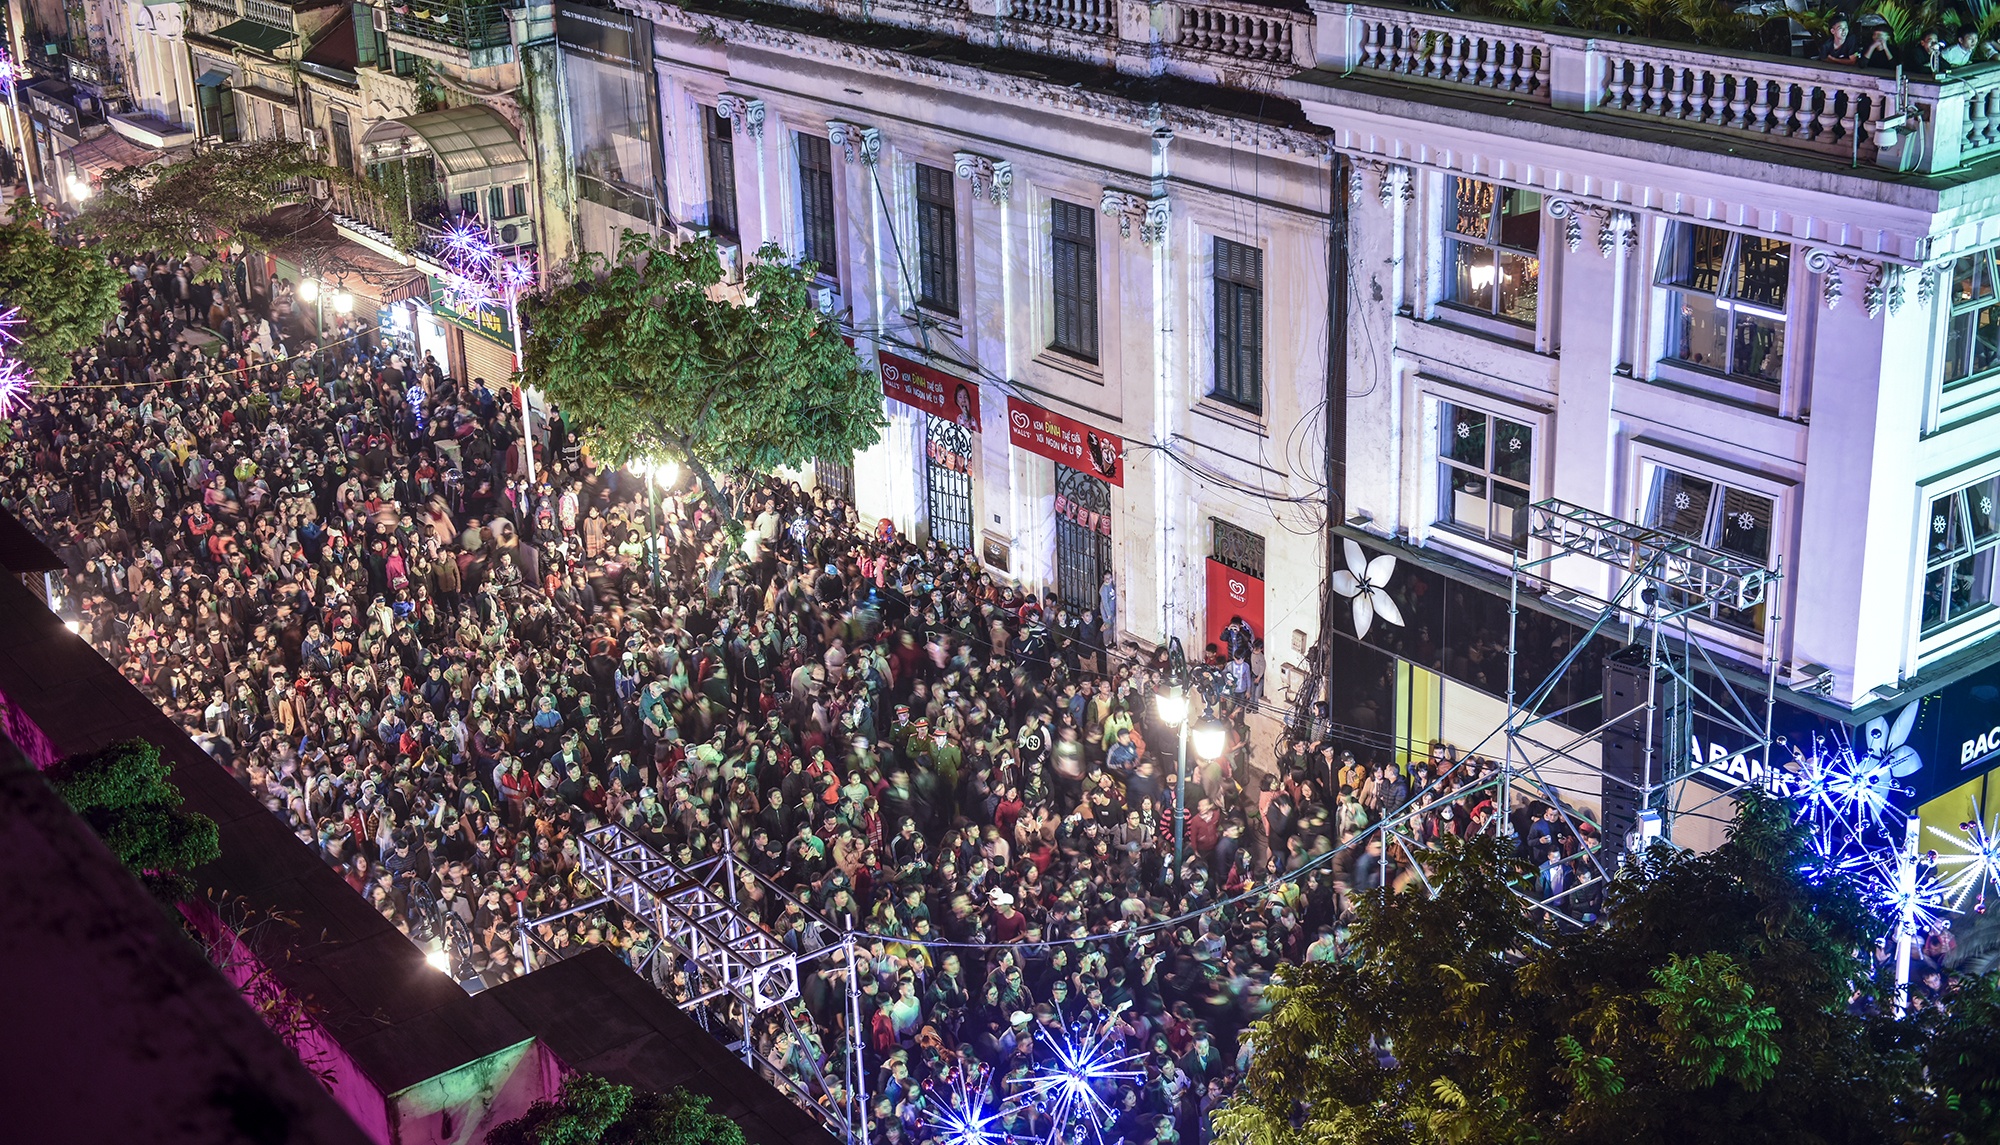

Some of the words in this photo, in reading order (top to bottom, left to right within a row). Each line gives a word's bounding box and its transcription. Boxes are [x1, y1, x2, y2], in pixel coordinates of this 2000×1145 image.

[1012, 426, 1031, 438] WALL'S
[1229, 592, 1246, 603] WALL'S
[1028, 738, 1039, 748] 69
[1709, 742, 1791, 797] BANK
